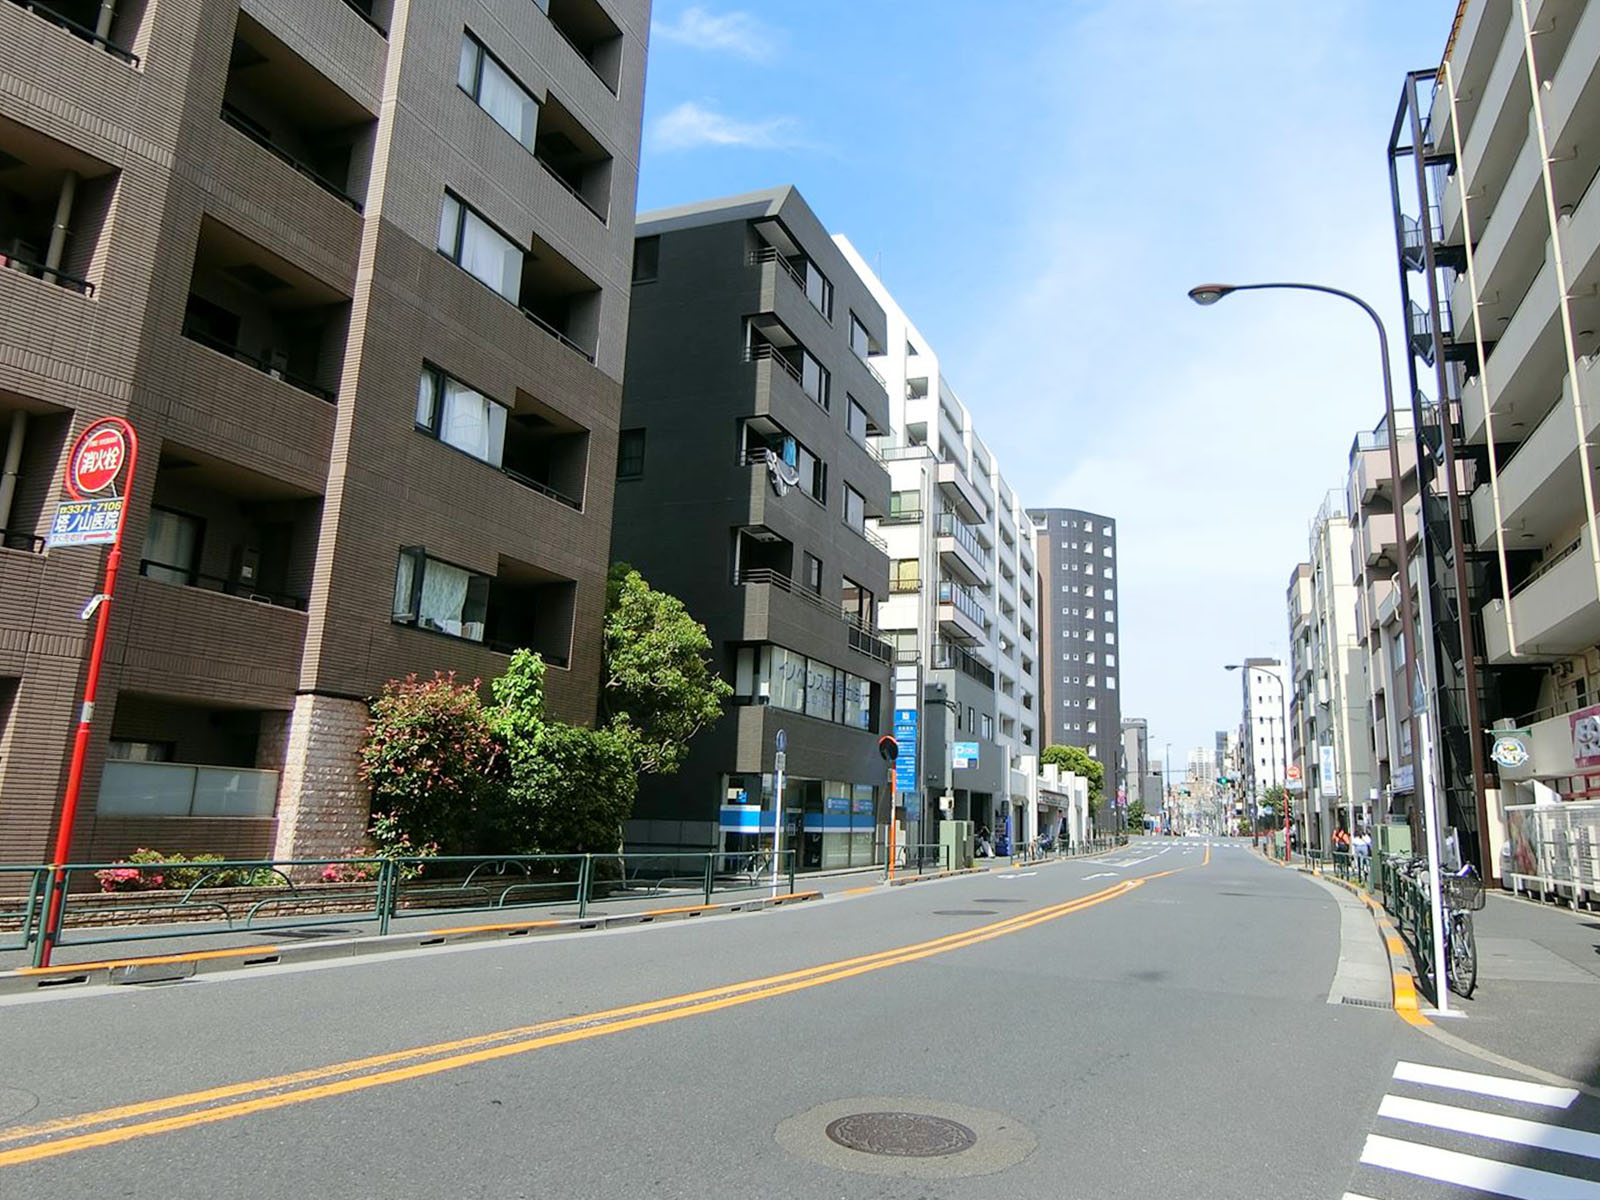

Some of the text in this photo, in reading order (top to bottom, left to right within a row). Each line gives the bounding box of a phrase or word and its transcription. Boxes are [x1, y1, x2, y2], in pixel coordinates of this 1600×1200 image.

[80, 447, 120, 474] 消火栓
[54, 510, 120, 533] 塔ノ山医院
